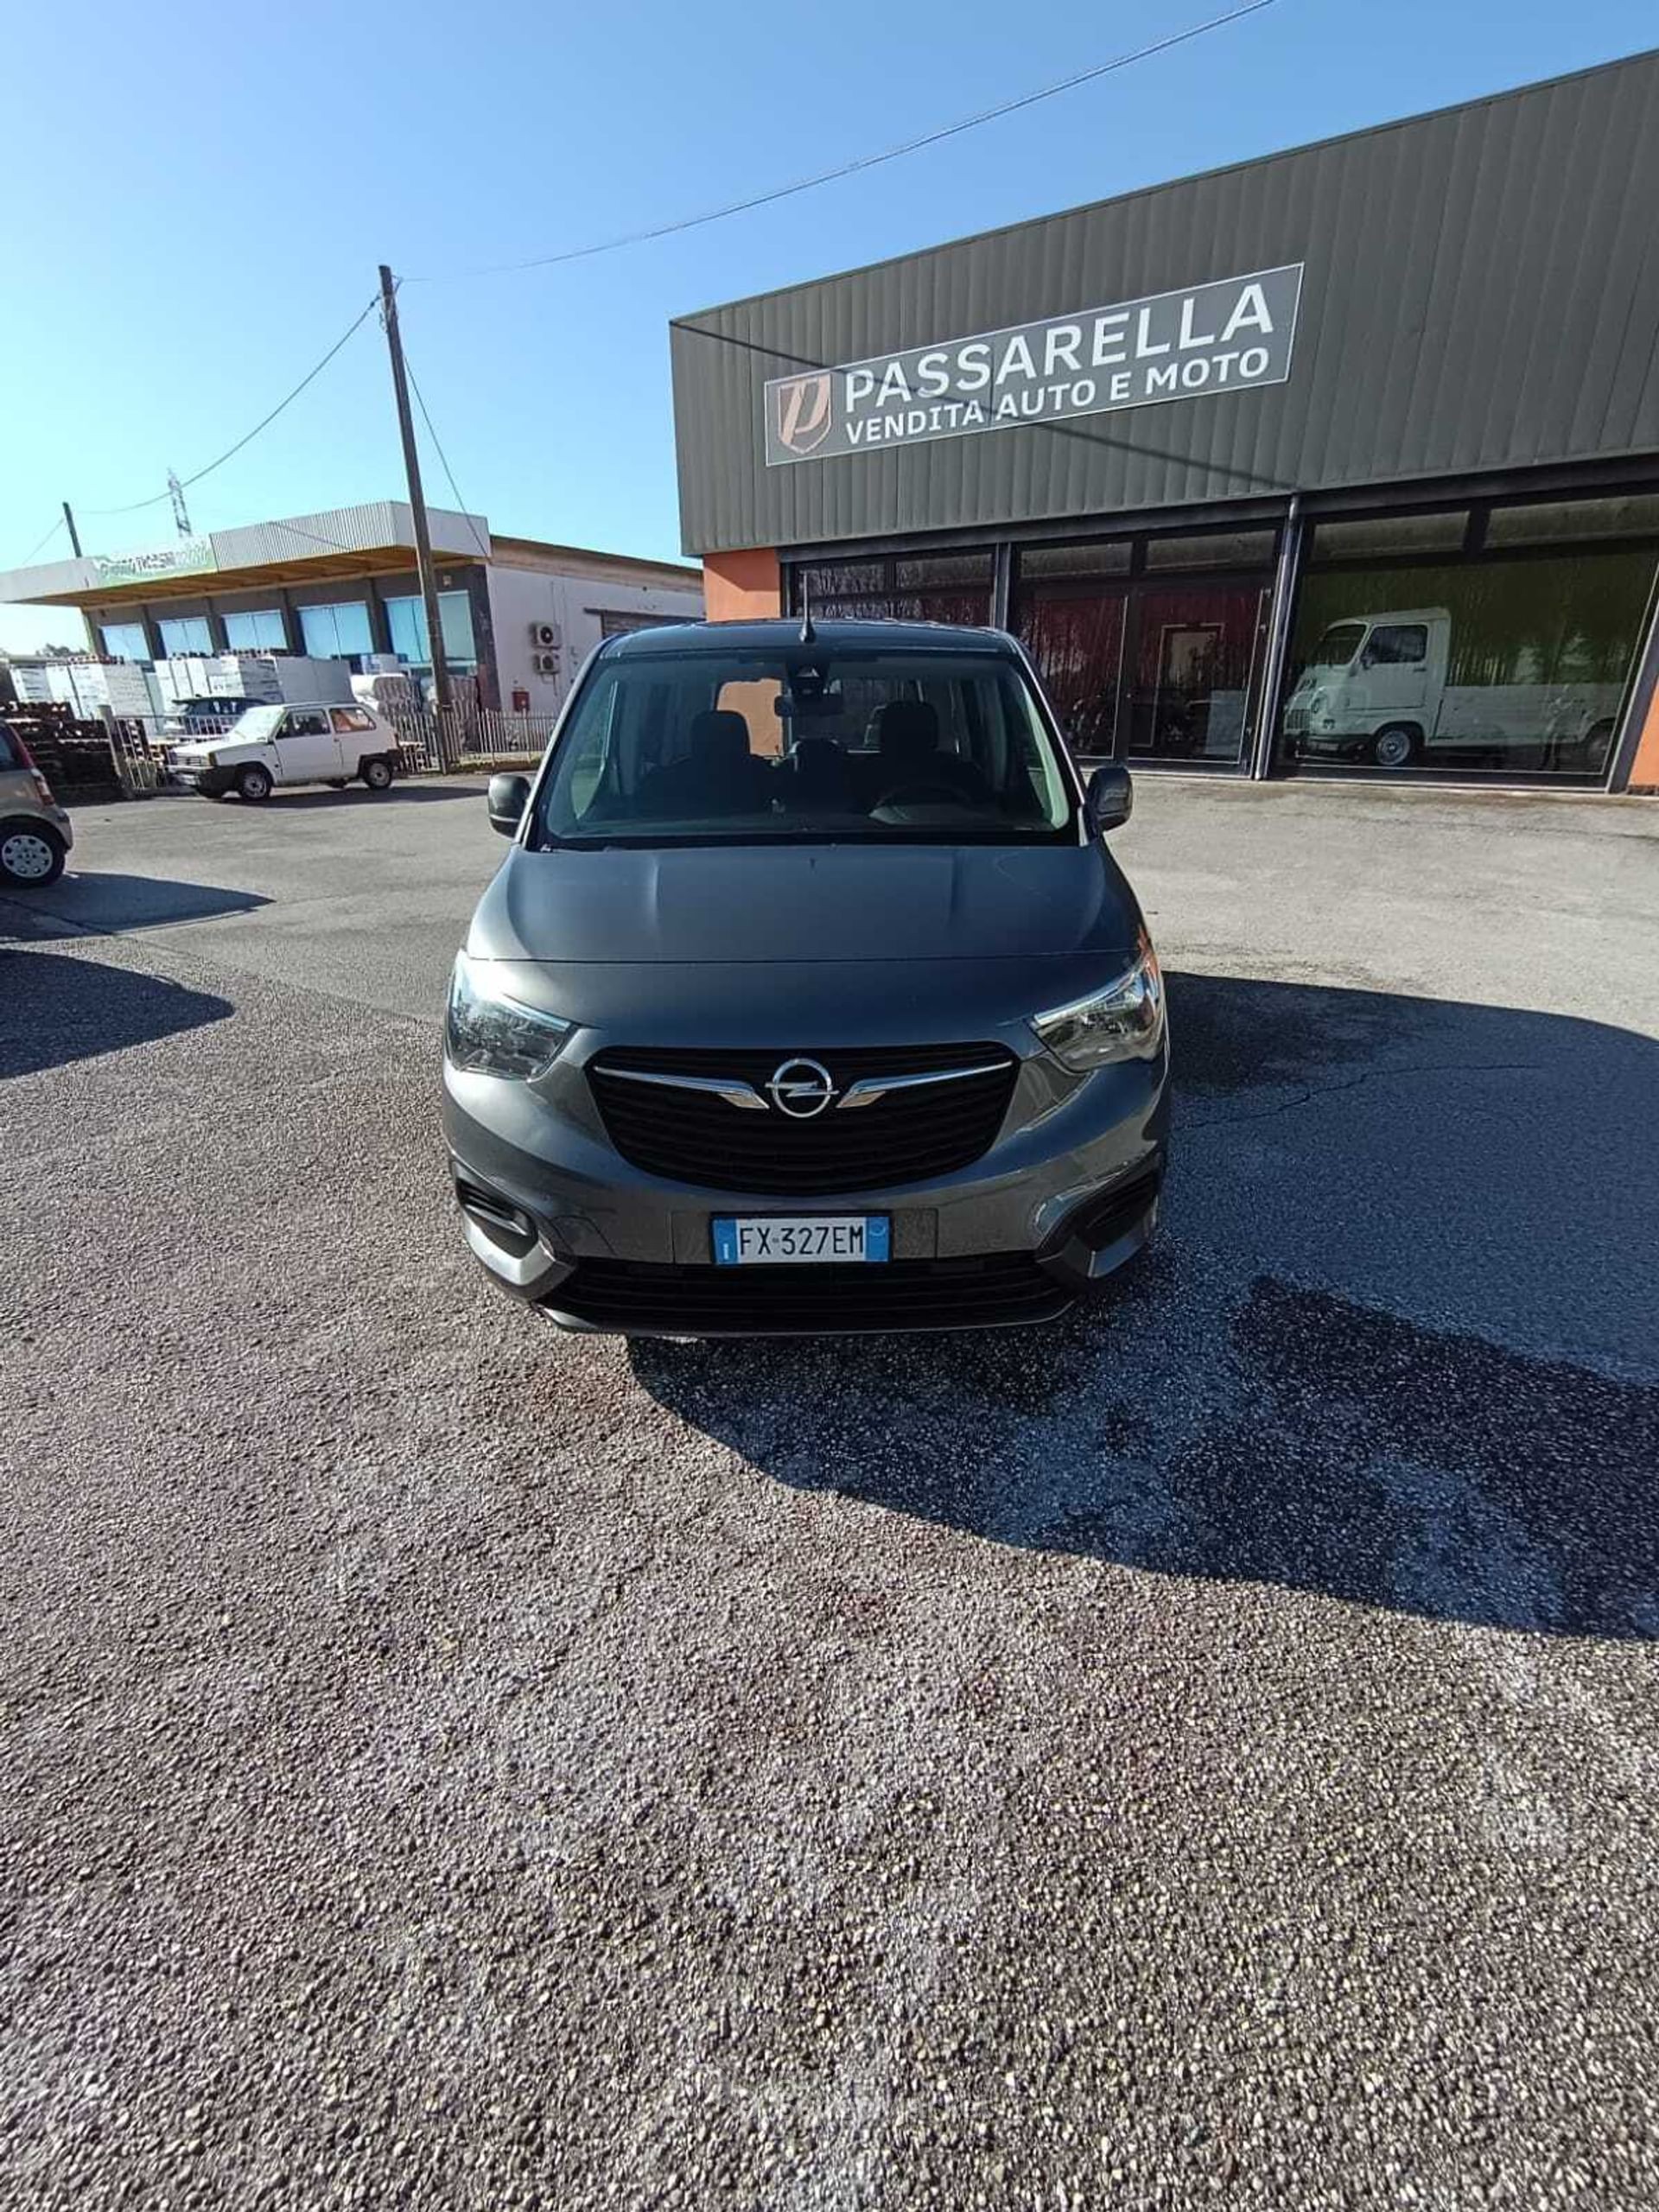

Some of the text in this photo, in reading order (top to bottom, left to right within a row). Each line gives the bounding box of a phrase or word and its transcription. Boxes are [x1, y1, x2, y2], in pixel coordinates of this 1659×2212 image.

[845, 283, 1274, 413] PASSARELLA
[846, 346, 1269, 444] VENDITA AUTO E MOTO
